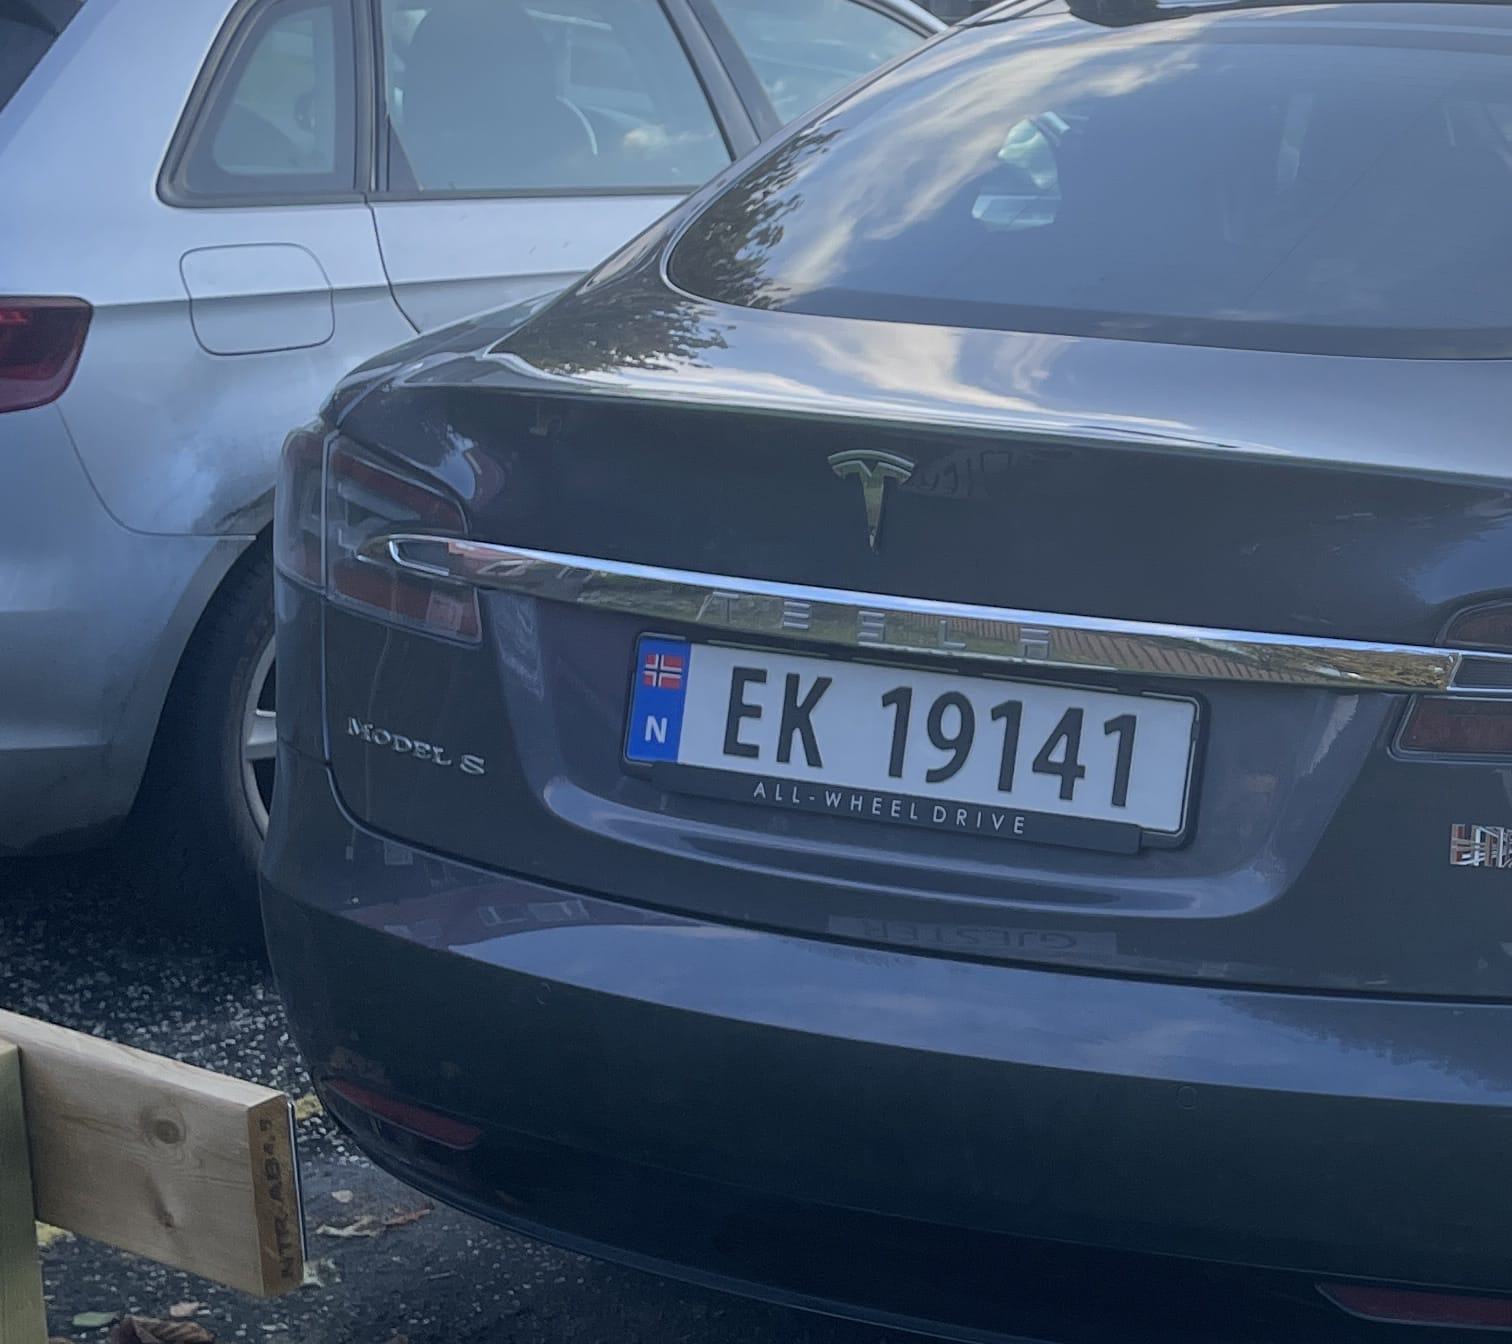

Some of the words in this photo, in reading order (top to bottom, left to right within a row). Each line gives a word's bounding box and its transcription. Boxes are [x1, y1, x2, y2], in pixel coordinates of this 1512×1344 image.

[347, 716, 452, 766] MODEL
[459, 754, 485, 775] S
[644, 715, 668, 745] N
[721, 665, 833, 769] EK
[880, 685, 1138, 809] 19141
[753, 781, 919, 821] ALL-WHEEL
[931, 804, 1026, 835] DRIVE
